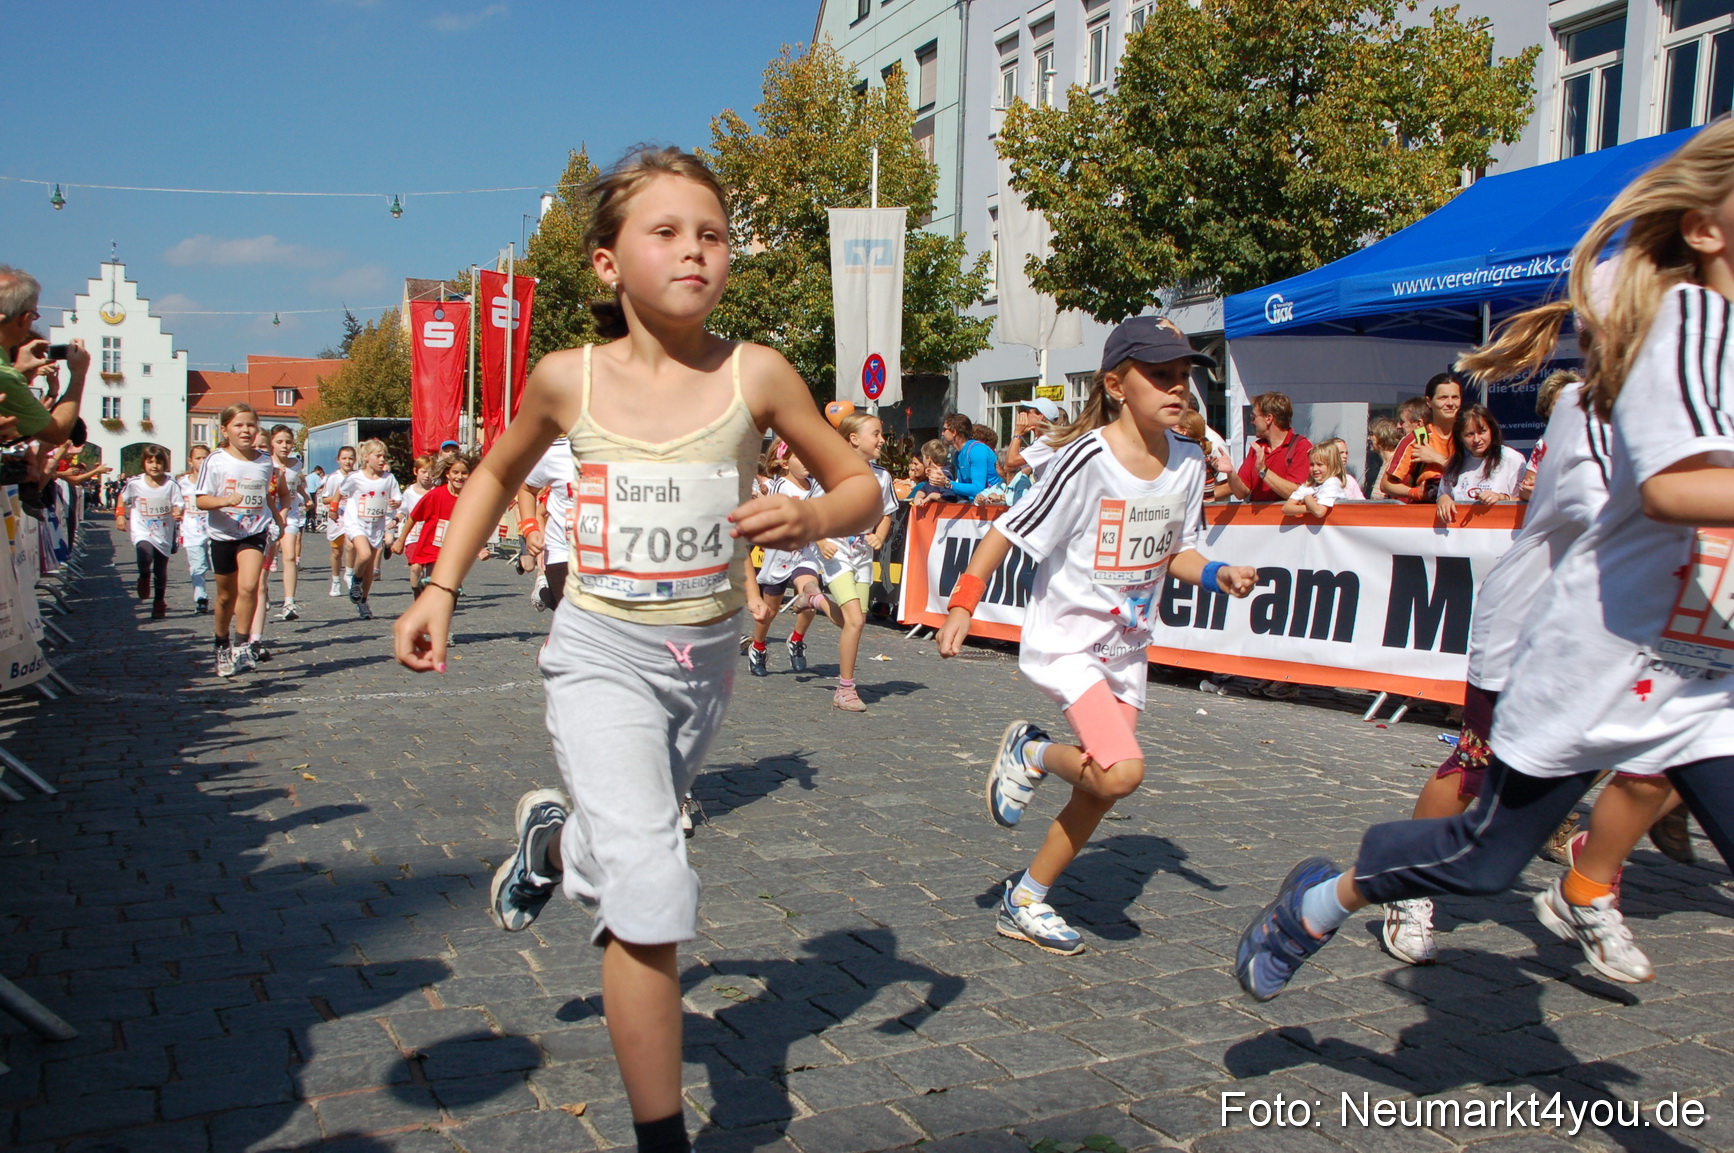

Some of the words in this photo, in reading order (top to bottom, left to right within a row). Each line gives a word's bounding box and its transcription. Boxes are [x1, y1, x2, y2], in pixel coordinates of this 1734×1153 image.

[1391, 251, 1576, 298] www.vereinigte-ikk.d
[1488, 384, 1508, 394] die
[1511, 383, 1540, 393] Leist
[616, 476, 681, 503] Sarah
[149, 505, 170, 514] 7188
[367, 507, 384, 516] 7264
[1128, 505, 1170, 523] Antonia
[579, 514, 599, 535] K3
[619, 523, 723, 564] 7084
[1101, 532, 1116, 545] K3
[1129, 530, 1173, 561] 7049
[1249, 566, 1360, 643] am
[1382, 554, 1474, 656] M
